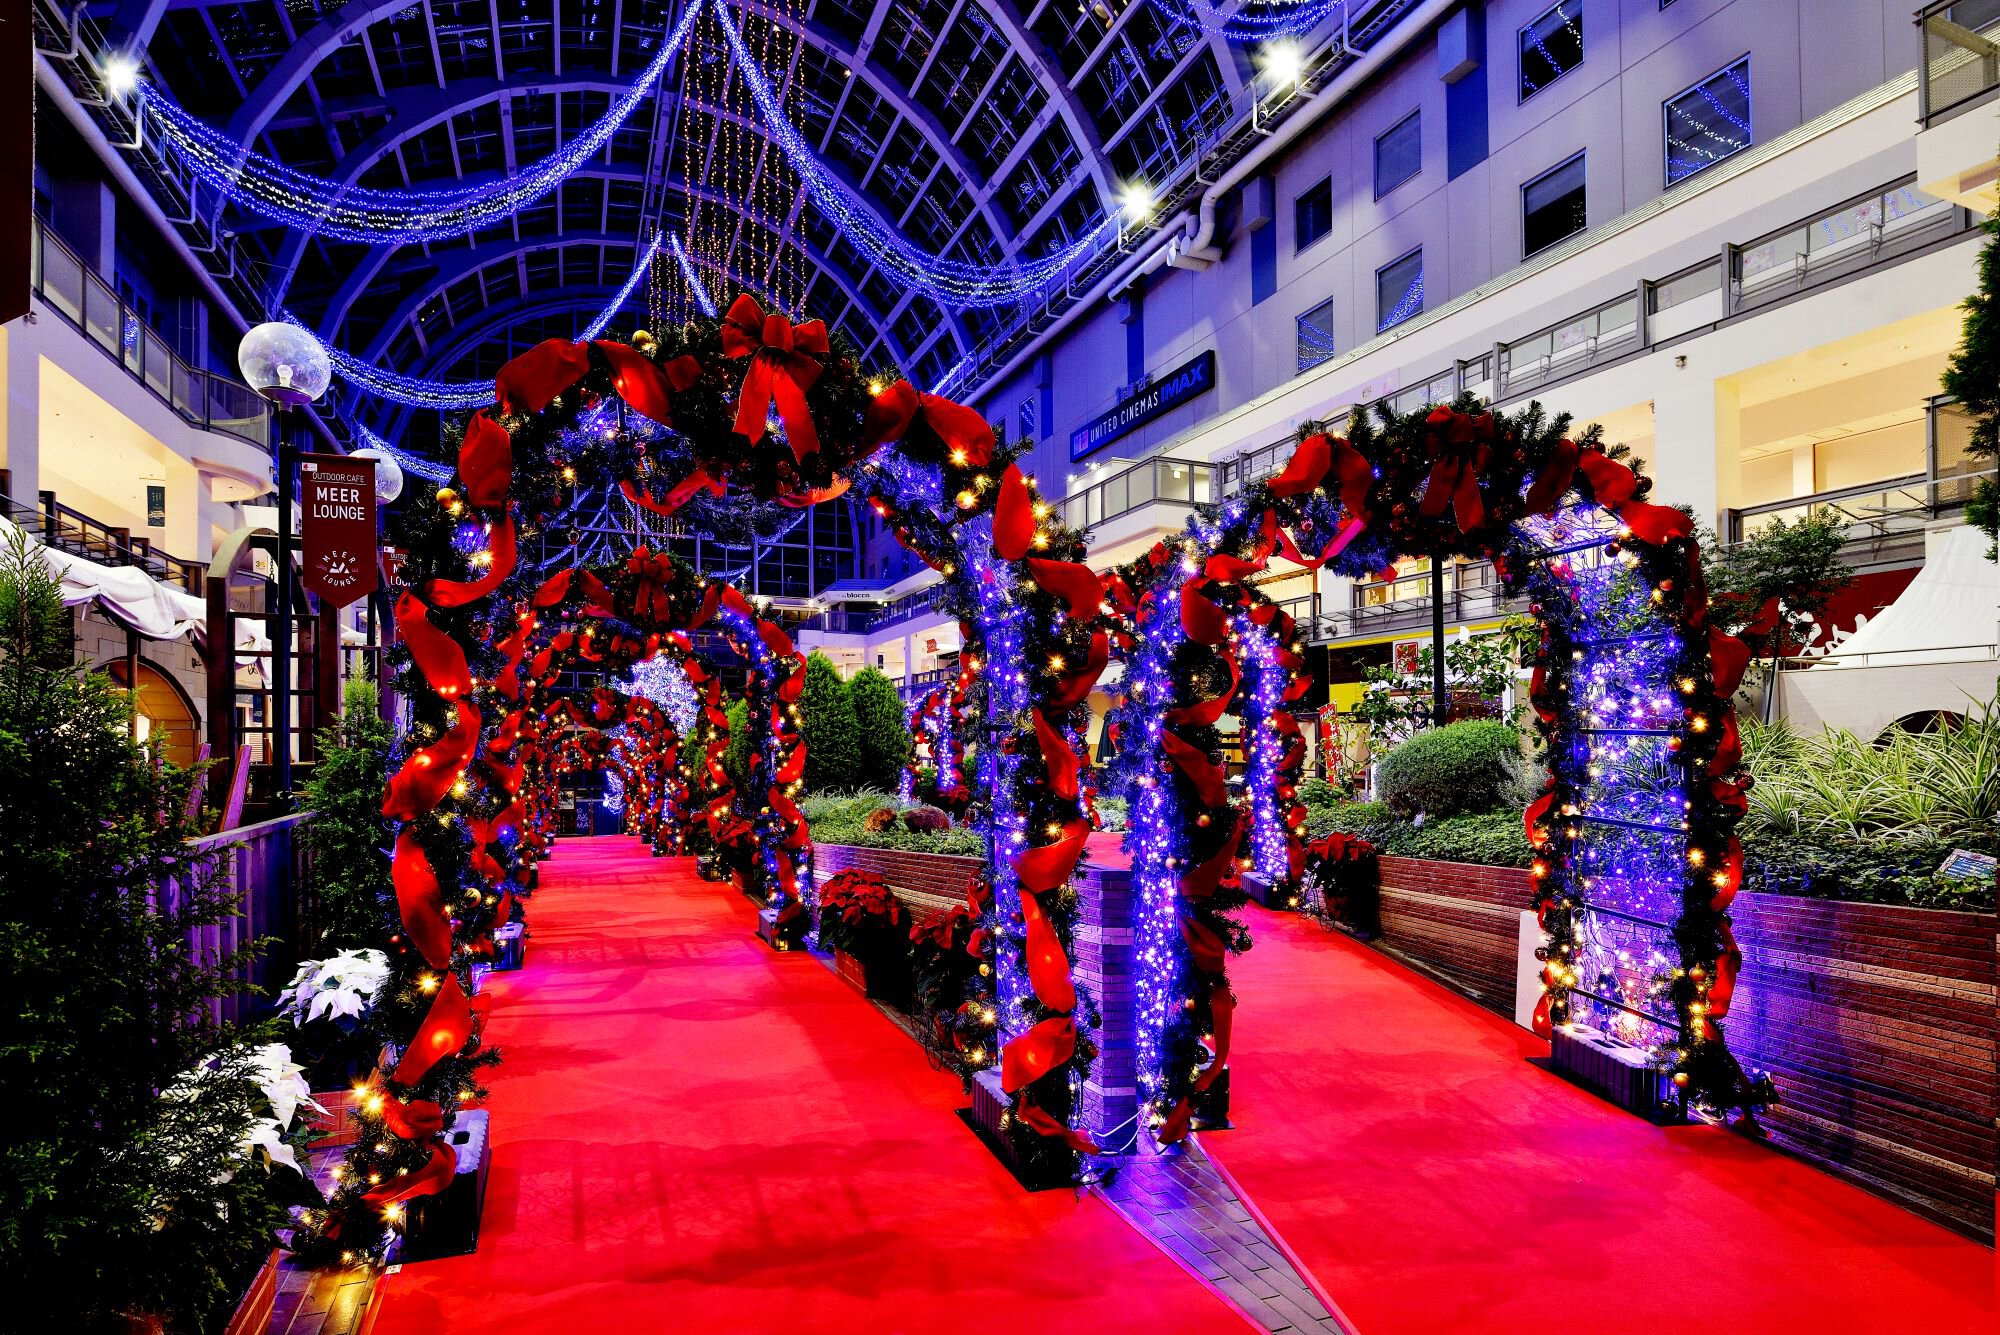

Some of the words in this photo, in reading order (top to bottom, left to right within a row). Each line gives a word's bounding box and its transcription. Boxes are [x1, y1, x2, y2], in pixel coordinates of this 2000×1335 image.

[1090, 415, 1117, 442] UNITED
[1120, 391, 1159, 425] CINEMAS
[1160, 367, 1204, 402] IMAX
[312, 471, 346, 482] OUTDOOR
[346, 474, 365, 483] CAFE
[316, 486, 360, 503] MEER
[313, 504, 366, 521] LOUNGE
[322, 550, 356, 564] MEER
[322, 574, 357, 587] LOUNGE
